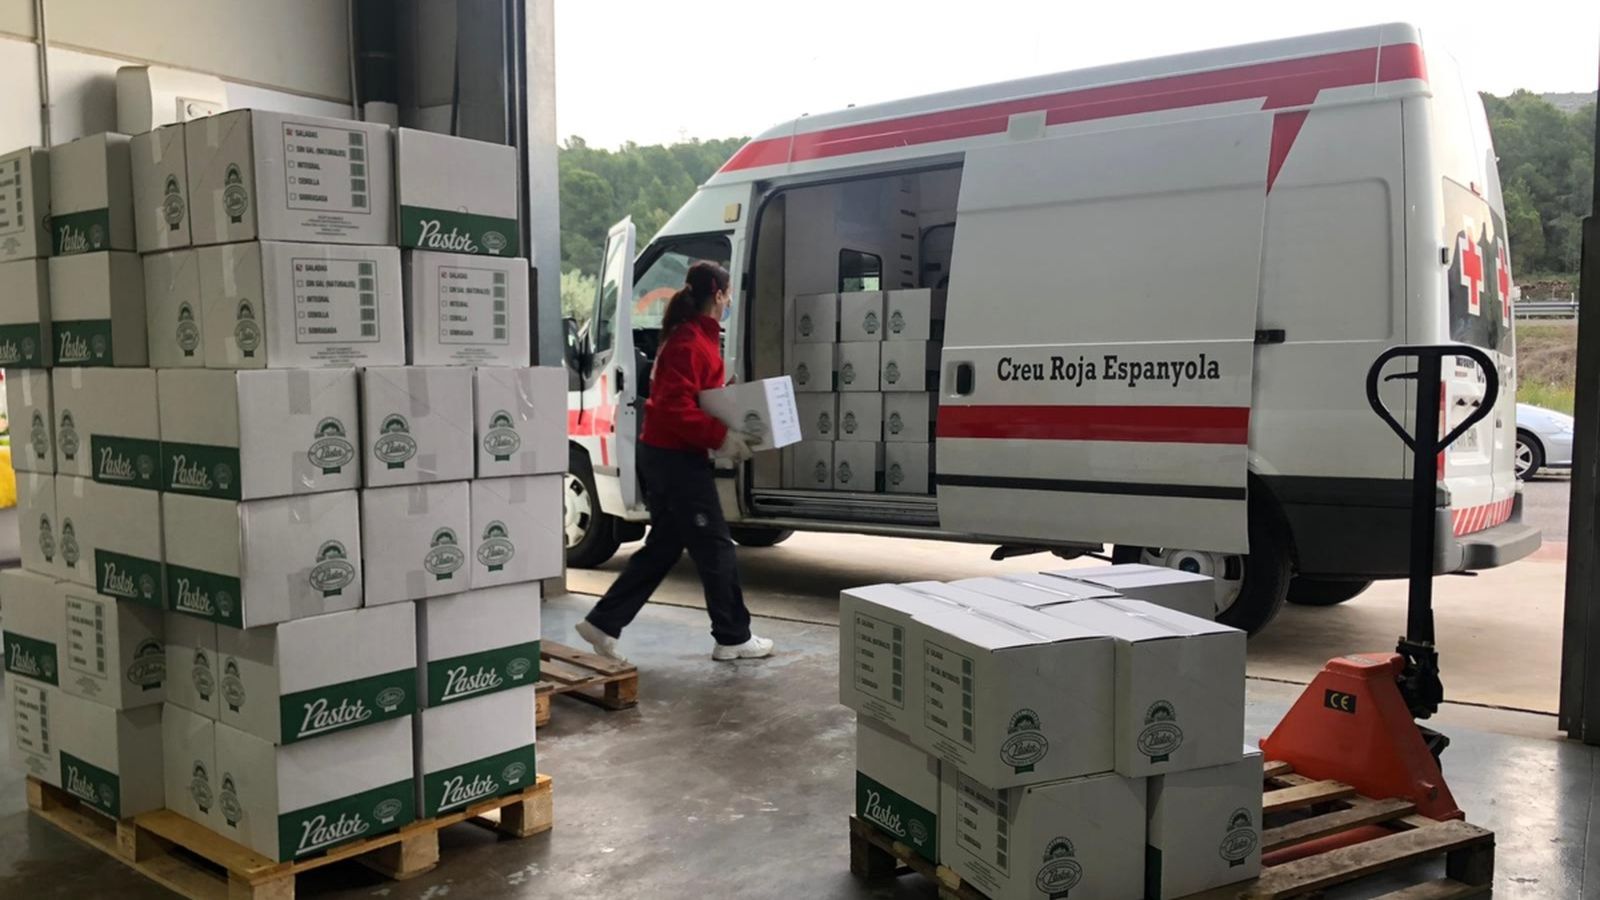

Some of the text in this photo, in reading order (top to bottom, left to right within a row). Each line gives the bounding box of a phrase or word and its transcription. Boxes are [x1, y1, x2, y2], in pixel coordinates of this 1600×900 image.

[59, 224, 90, 255] Pastor
[417, 219, 478, 253] Pastor
[58, 331, 91, 362] Pastor
[997, 354, 1220, 387] Creu Roja Espanyola
[98, 446, 137, 480] Pastor
[171, 454, 213, 490] Pastor
[103, 562, 138, 597] Pastor
[176, 577, 216, 615] Pastor
[10, 643, 41, 675] Pastor
[441, 666, 503, 701] Pastor
[1329, 692, 1349, 710] CE
[296, 698, 372, 739] Pastor
[437, 775, 499, 813] Pastor
[864, 789, 906, 837] Pastor
[295, 814, 370, 856] Pastor
